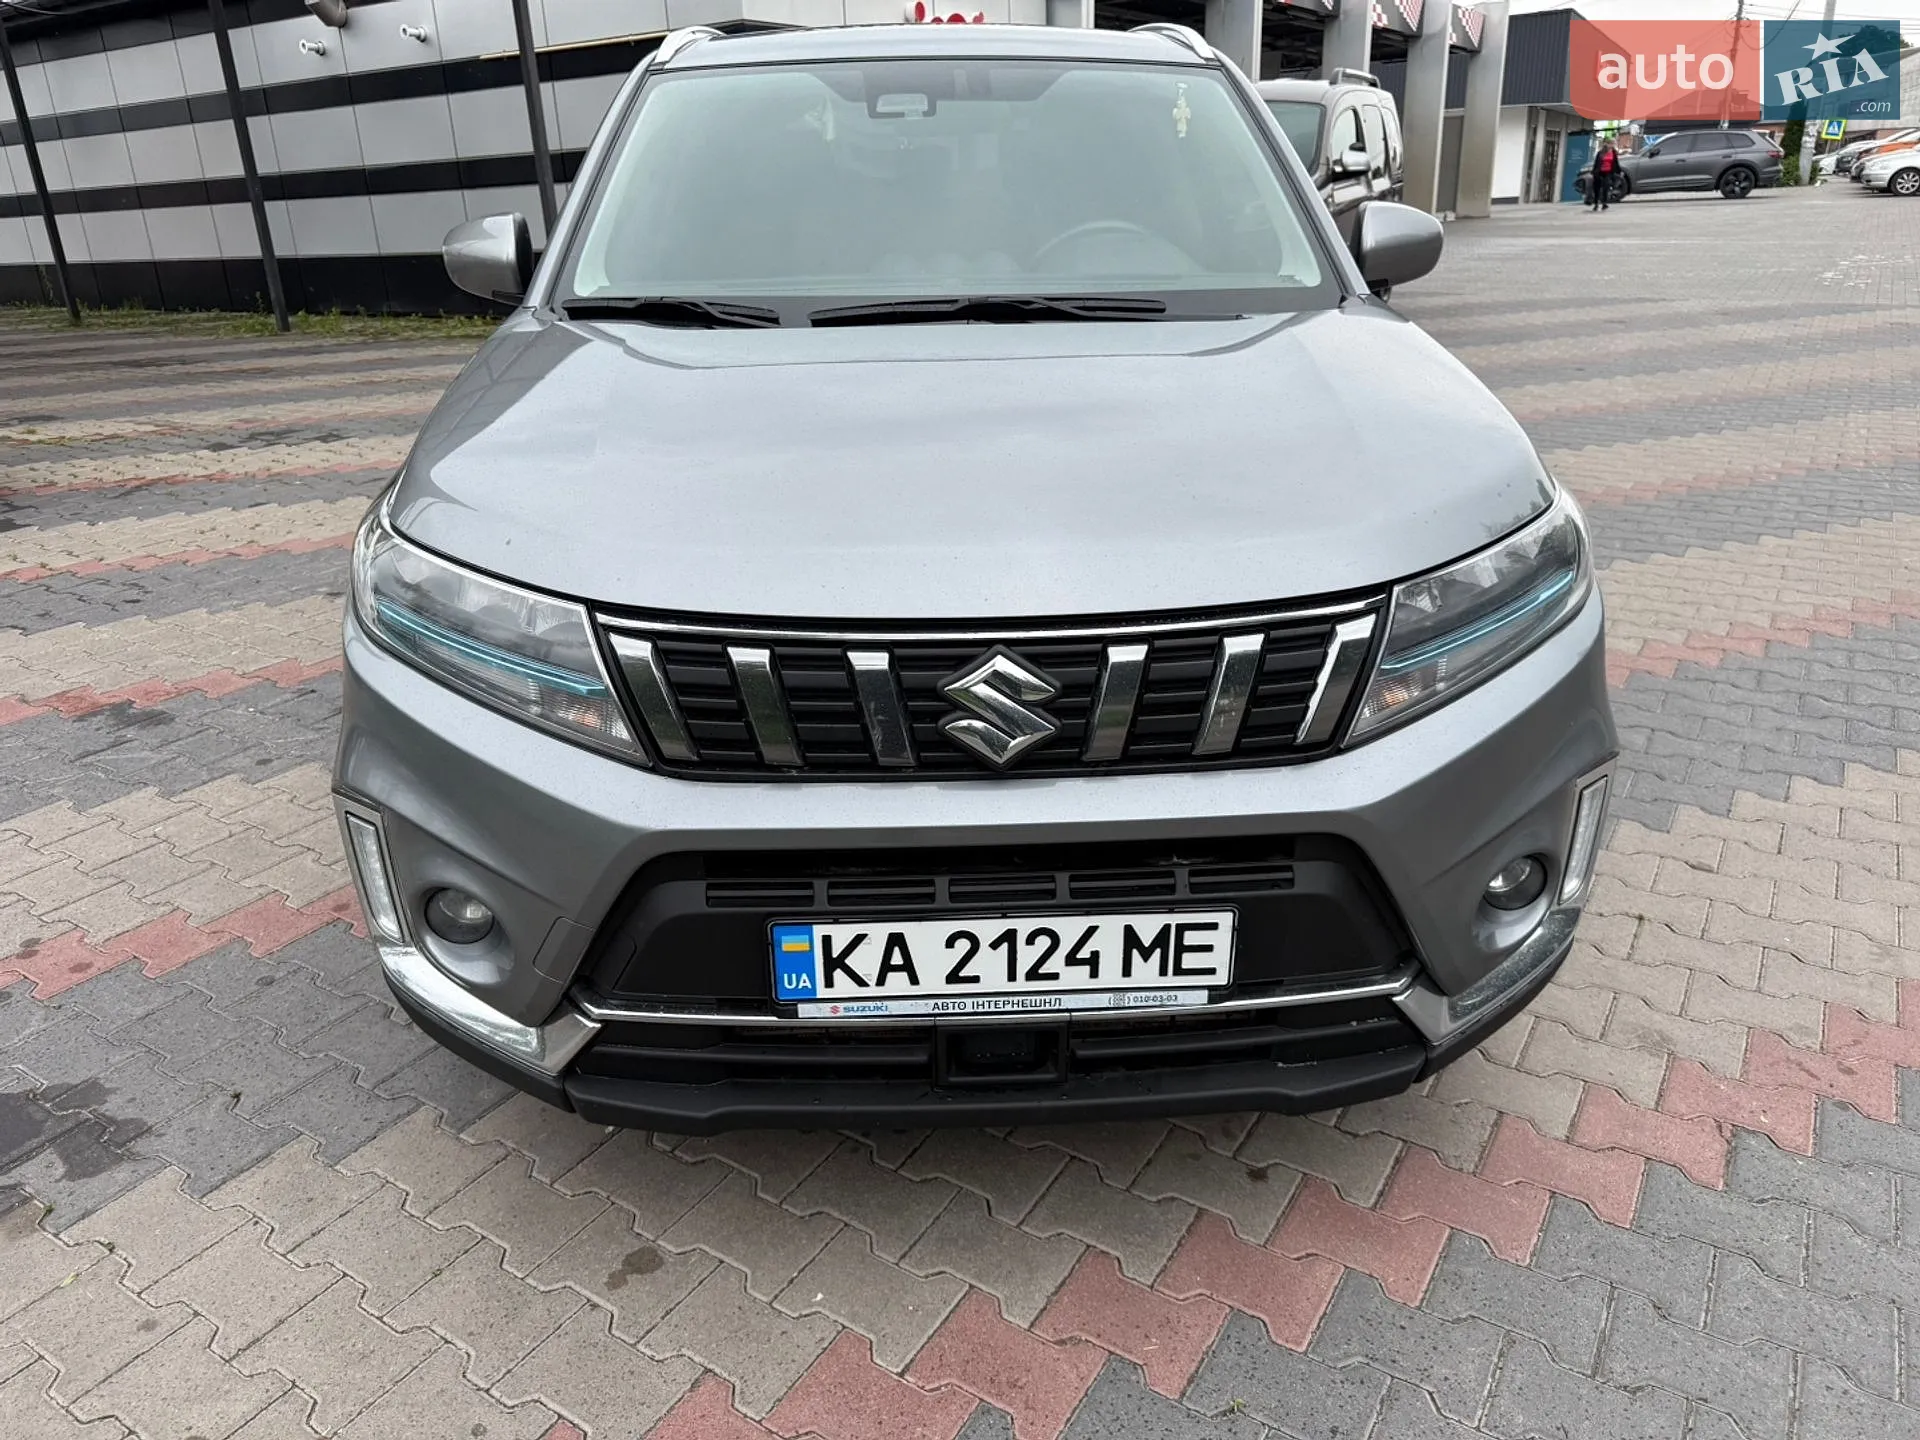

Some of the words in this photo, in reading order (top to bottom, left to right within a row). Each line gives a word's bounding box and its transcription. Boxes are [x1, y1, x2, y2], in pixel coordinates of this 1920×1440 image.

[821, 932, 920, 989] KA
[944, 925, 1100, 985] 2124
[1122, 921, 1219, 977] ME
[783, 973, 812, 990] UA
[843, 1004, 889, 1013] SUZUKI
[932, 1001, 967, 1011] АВТО
[972, 998, 1062, 1010] ІНТЕРНЕШНЛ
